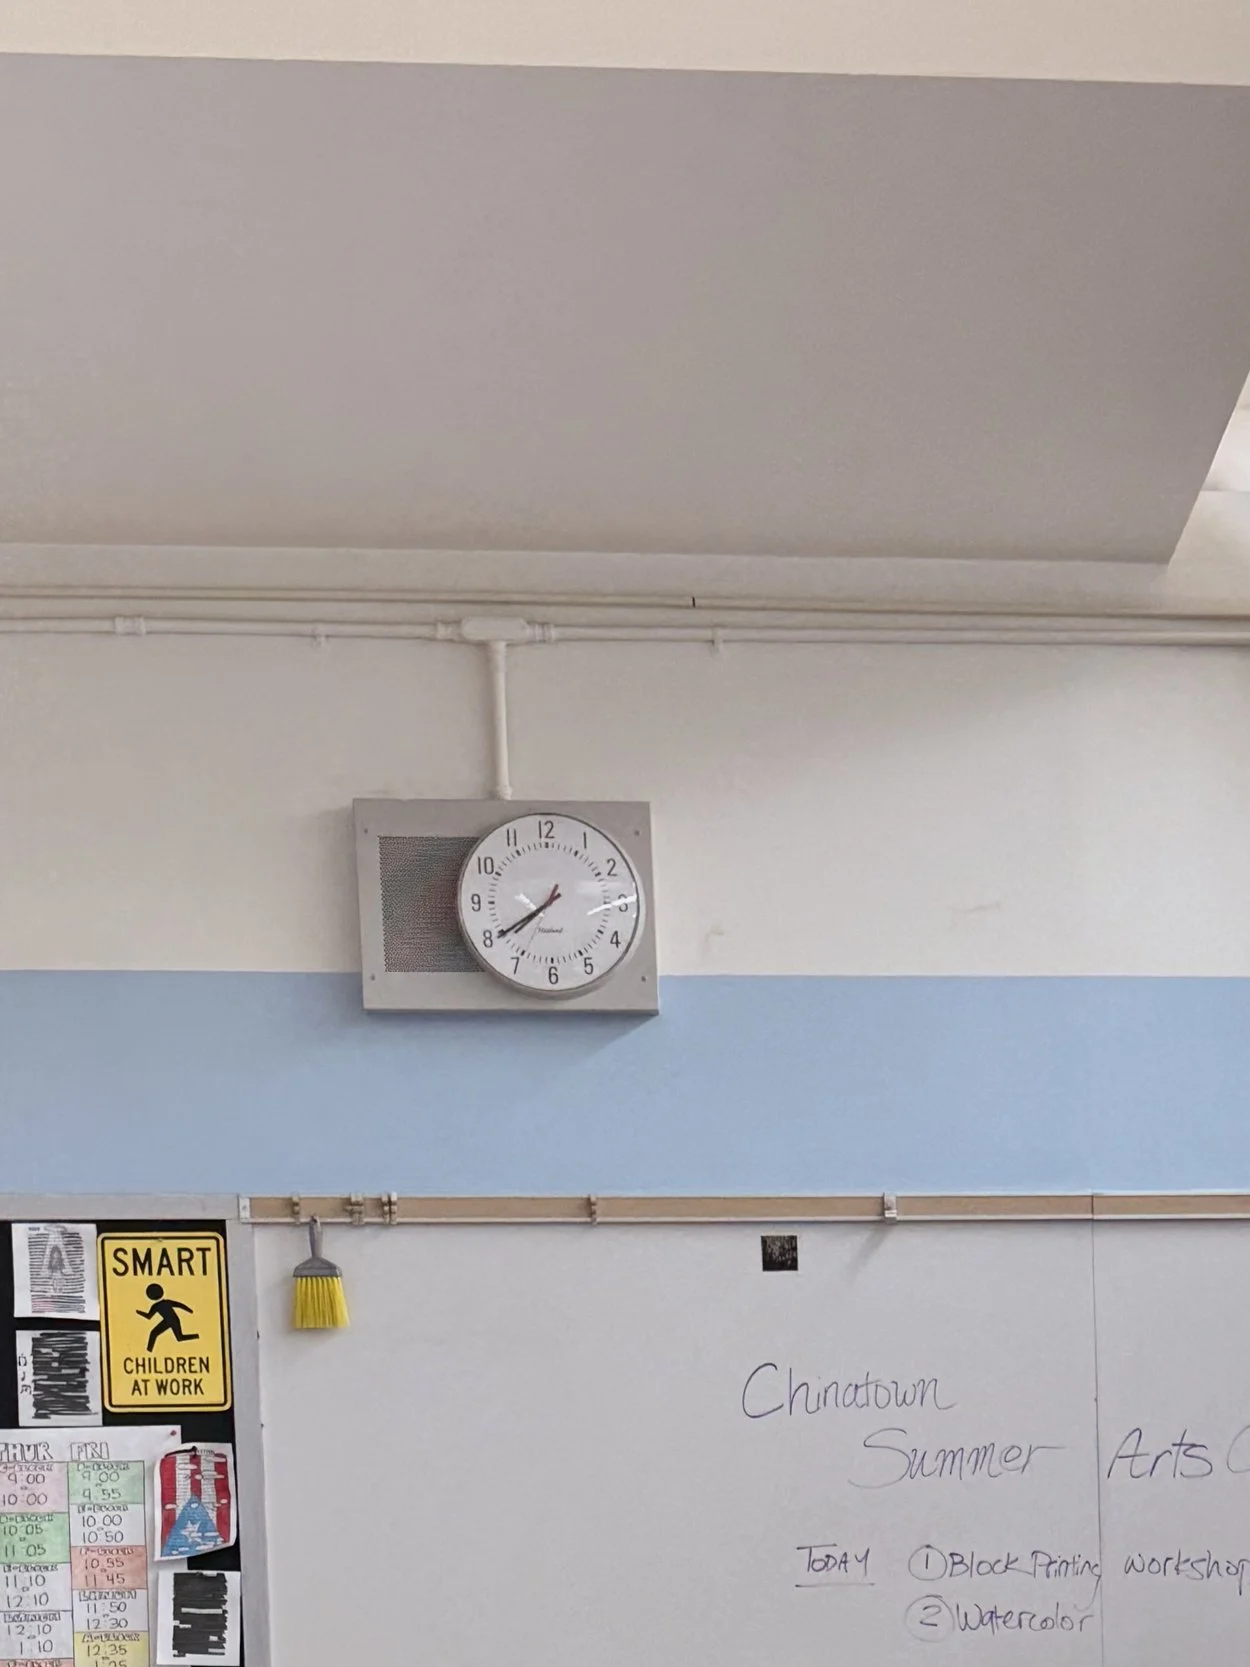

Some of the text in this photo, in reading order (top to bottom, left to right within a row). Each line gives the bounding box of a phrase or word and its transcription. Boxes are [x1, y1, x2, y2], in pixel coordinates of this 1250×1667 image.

[506, 828, 517, 847] 11
[538, 820, 555, 839] 12
[583, 832, 588, 849] 1
[477, 856, 495, 875] 10
[606, 858, 618, 877] 2
[471, 893, 481, 912] 9
[483, 930, 493, 949] 8
[610, 930, 621, 949] 4
[510, 957, 520, 975] 7
[548, 966, 559, 985] 6
[584, 957, 593, 975] 5
[112, 1247, 211, 1276] SMART
[123, 1356, 210, 1374] CHILDREN
[131, 1379, 205, 1396] AT WORK
[742, 1362, 957, 1418] Chinatown
[70, 1442, 110, 1461] FRI
[847, 1427, 1067, 1489] Summer
[1107, 1428, 1214, 1478] Arts
[949, 1551, 1026, 1579] Block
[1031, 1550, 1102, 1611] Printing
[956, 1601, 1096, 1636] Watercolor
